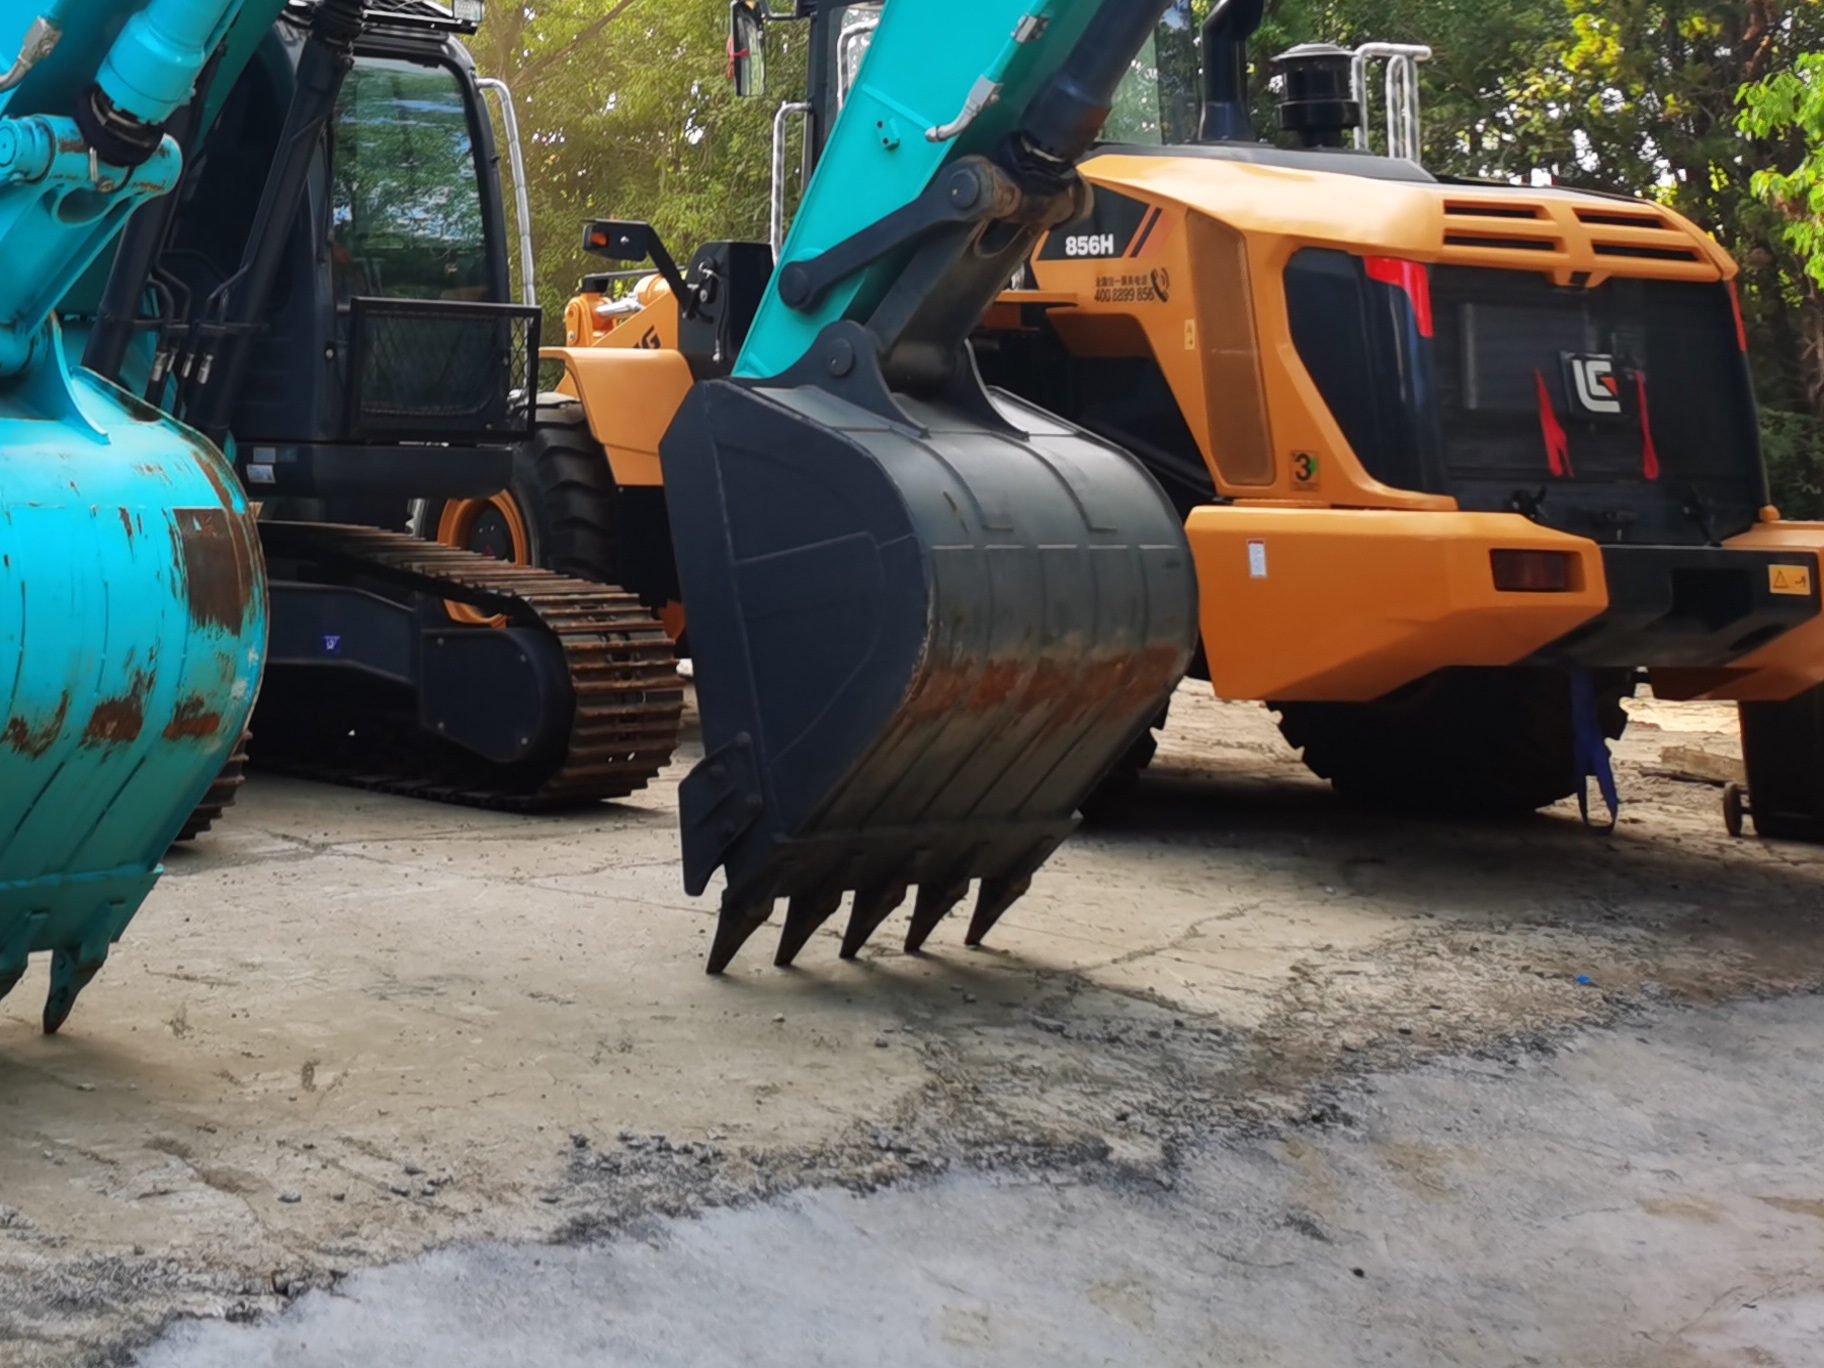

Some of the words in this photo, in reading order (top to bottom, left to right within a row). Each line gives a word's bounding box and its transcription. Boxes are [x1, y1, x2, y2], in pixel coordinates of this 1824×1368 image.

[1065, 233, 1114, 256] 856H
[1094, 288, 1111, 303] 400
[1295, 453, 1313, 482] 3
